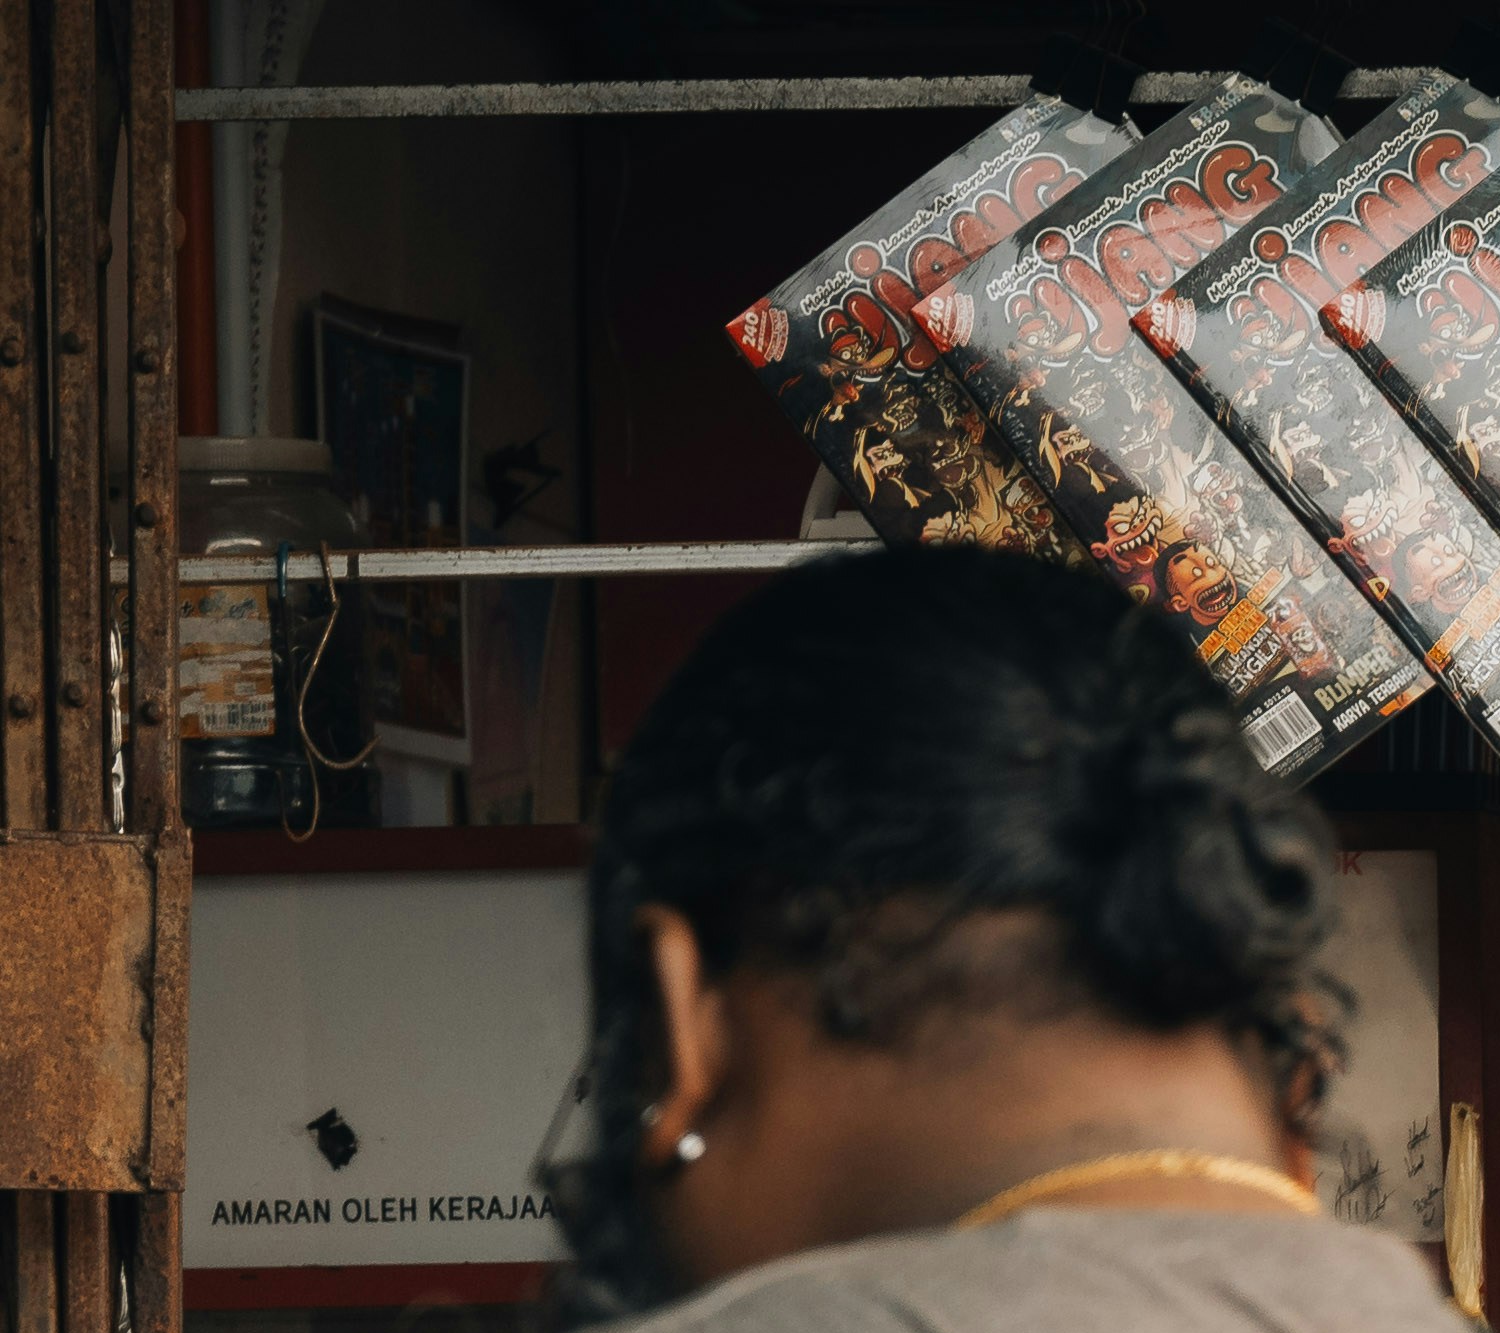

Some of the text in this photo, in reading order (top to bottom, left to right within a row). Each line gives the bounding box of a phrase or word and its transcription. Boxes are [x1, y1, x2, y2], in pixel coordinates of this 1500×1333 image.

[802, 132, 1041, 314] Majalah Lawak Antarabangsa
[986, 120, 1229, 299] Majalah Lawak Antarabangsa
[1208, 109, 1438, 302] Majalah Lawak Antarabangsa
[1398, 251, 1448, 295] Majalah
[1333, 699, 1370, 732] KARYA
[211, 1195, 557, 1226] AMARAN OLEH KERAJAA
